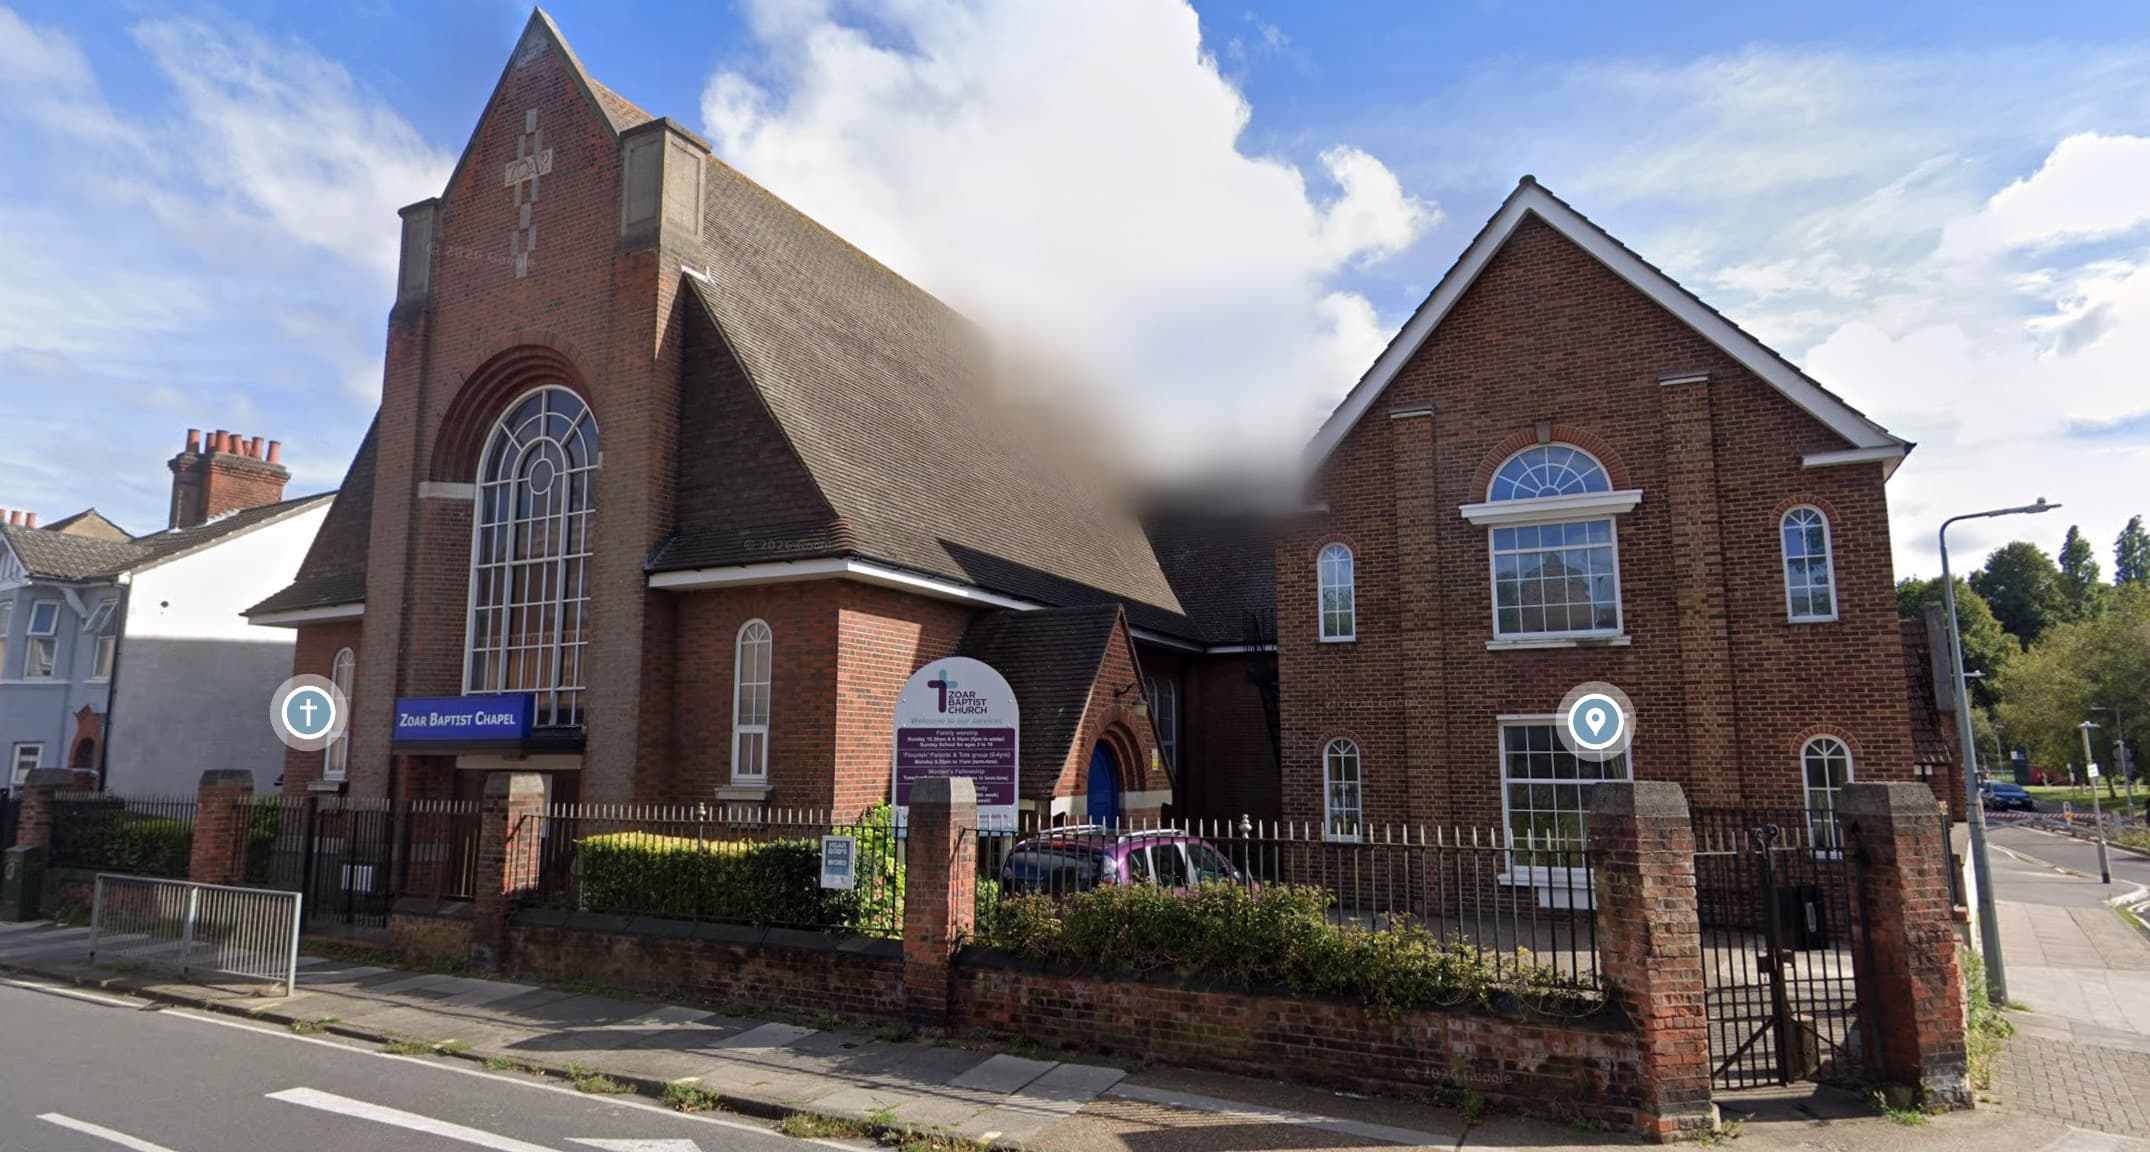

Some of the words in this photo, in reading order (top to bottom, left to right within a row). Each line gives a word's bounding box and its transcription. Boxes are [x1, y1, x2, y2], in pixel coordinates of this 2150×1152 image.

[948, 690, 976, 699] ZOAR
[948, 698, 988, 706] BAPTIST
[948, 706, 988, 714] CHURCH
